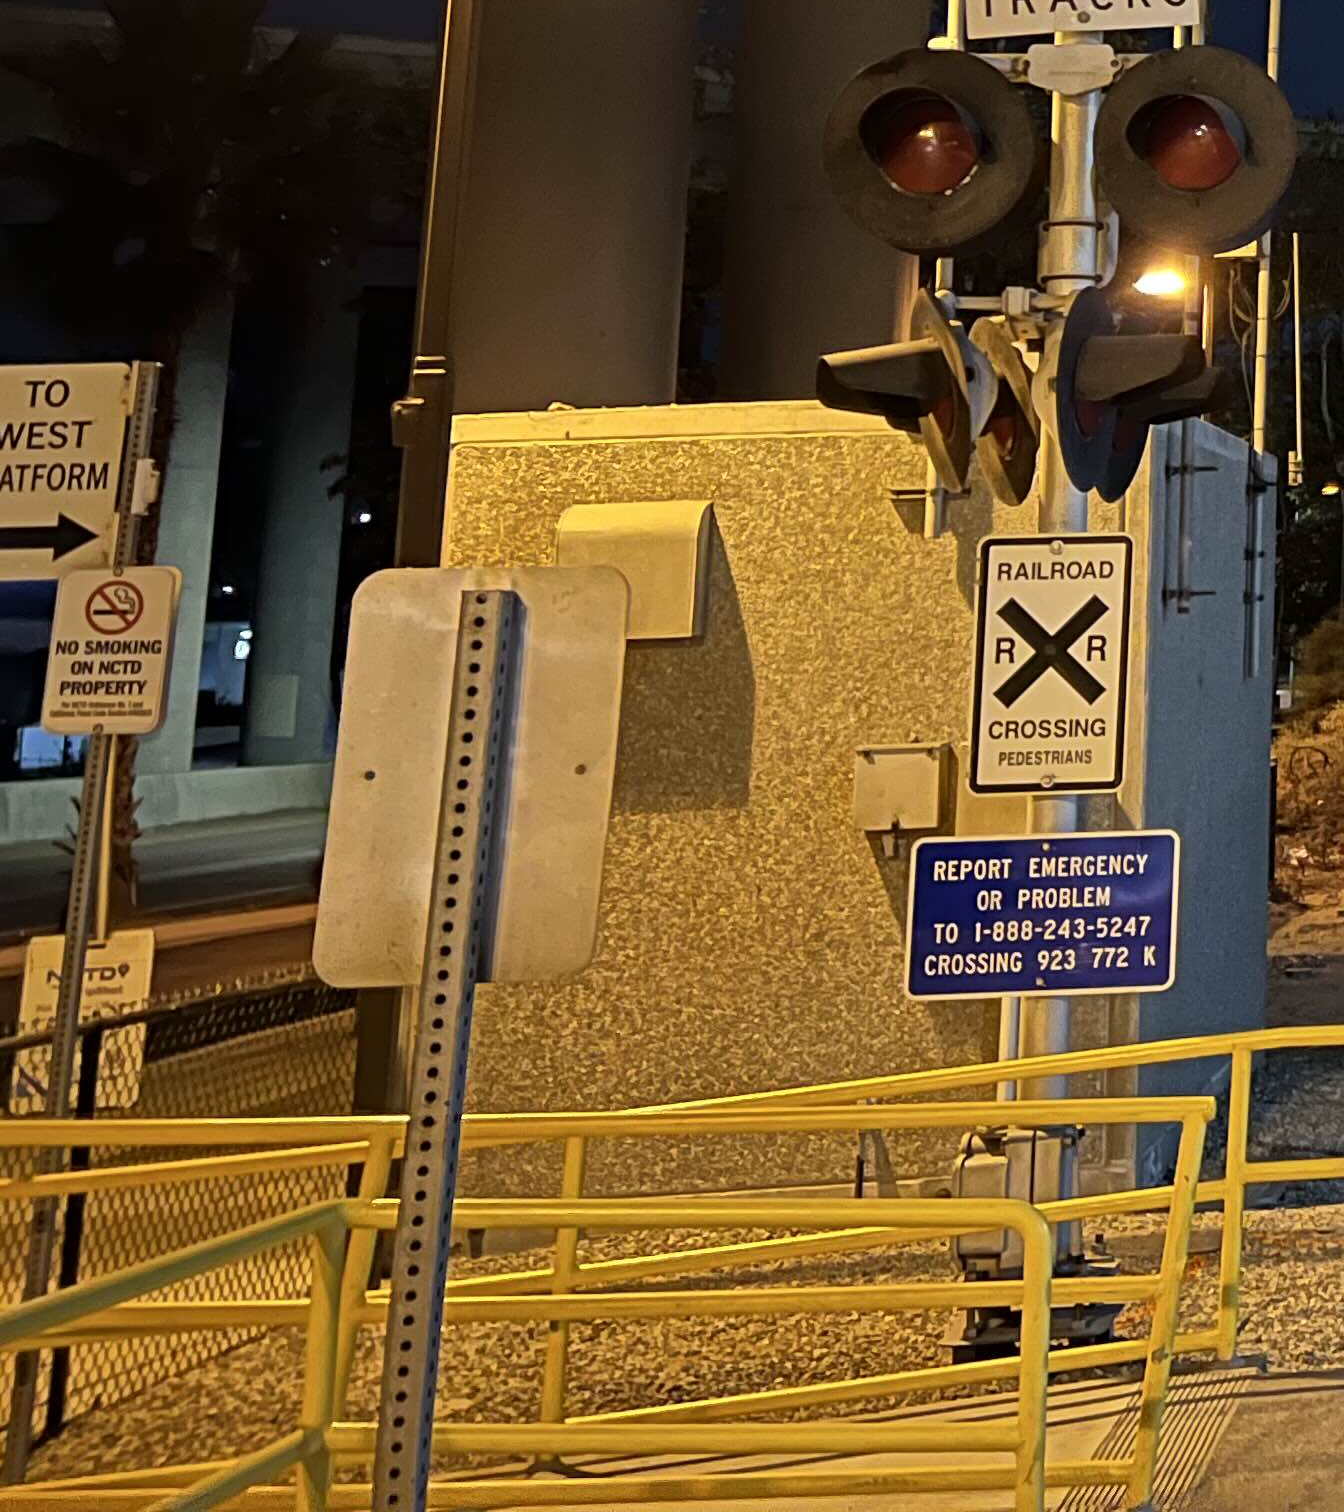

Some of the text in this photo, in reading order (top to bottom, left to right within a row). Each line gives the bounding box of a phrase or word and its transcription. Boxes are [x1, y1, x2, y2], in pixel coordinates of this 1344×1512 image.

[24, 379, 70, 408] TO
[997, 560, 1114, 581] RAILROAD
[55, 639, 162, 655] NO SMOKING
[994, 635, 1107, 664] R R
[70, 660, 142, 675] ON NCTD
[59, 679, 147, 696] PROPERTY
[988, 718, 1106, 739] CROSSING
[998, 749, 1092, 766] PEDESTRIANS
[933, 854, 1148, 881] REPORT EMERGENCY
[977, 887, 1110, 911] OR PROBLEM
[934, 916, 1151, 943] TO 1-888-243-5247
[924, 945, 1156, 976] CROSSING 923 772 K
